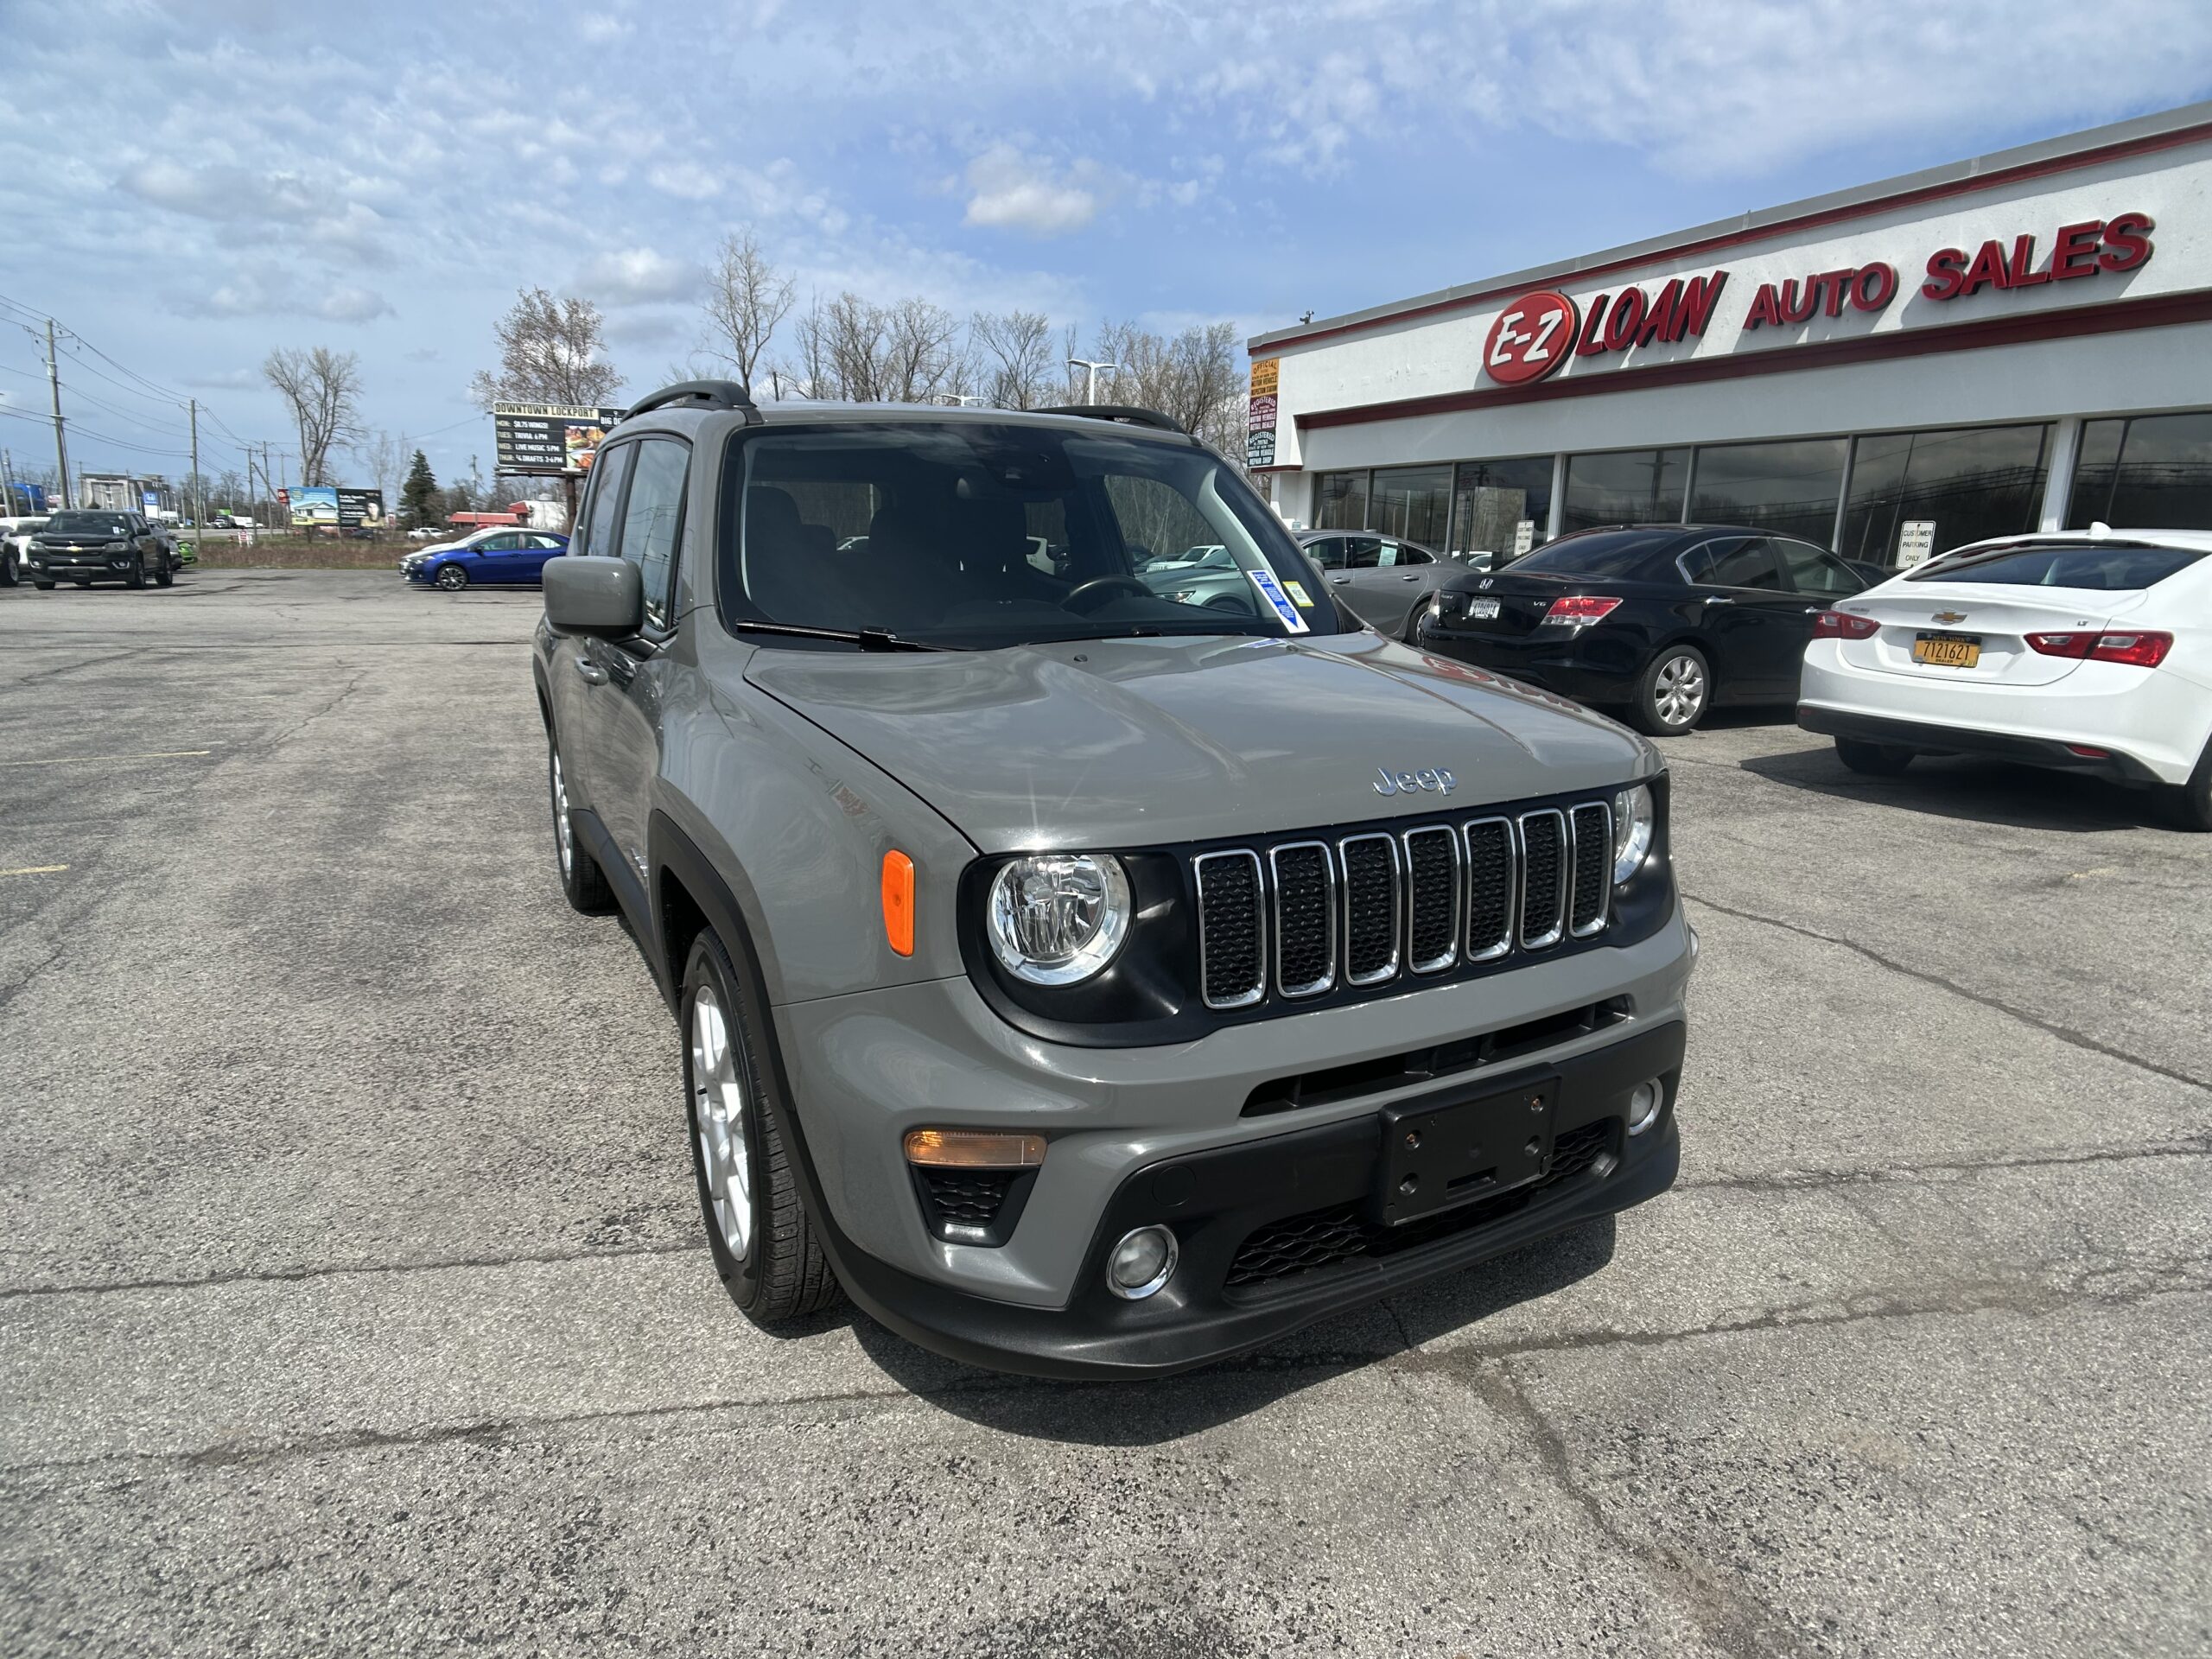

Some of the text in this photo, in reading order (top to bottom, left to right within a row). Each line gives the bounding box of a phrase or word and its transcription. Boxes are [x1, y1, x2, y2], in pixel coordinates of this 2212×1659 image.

[1490, 212, 2156, 366] E-Z LOAN AUTO SALES
[1254, 360, 1277, 374] OFFICIAL
[1251, 396, 1276, 410] REGISTERED
[496, 404, 594, 417] DOWNTOWN LOCKPORT
[601, 416, 613, 425] BIG
[1249, 431, 1274, 445] REGISTERED
[1923, 641, 1970, 660] 7121621
[1373, 767, 1458, 797] Jeep
